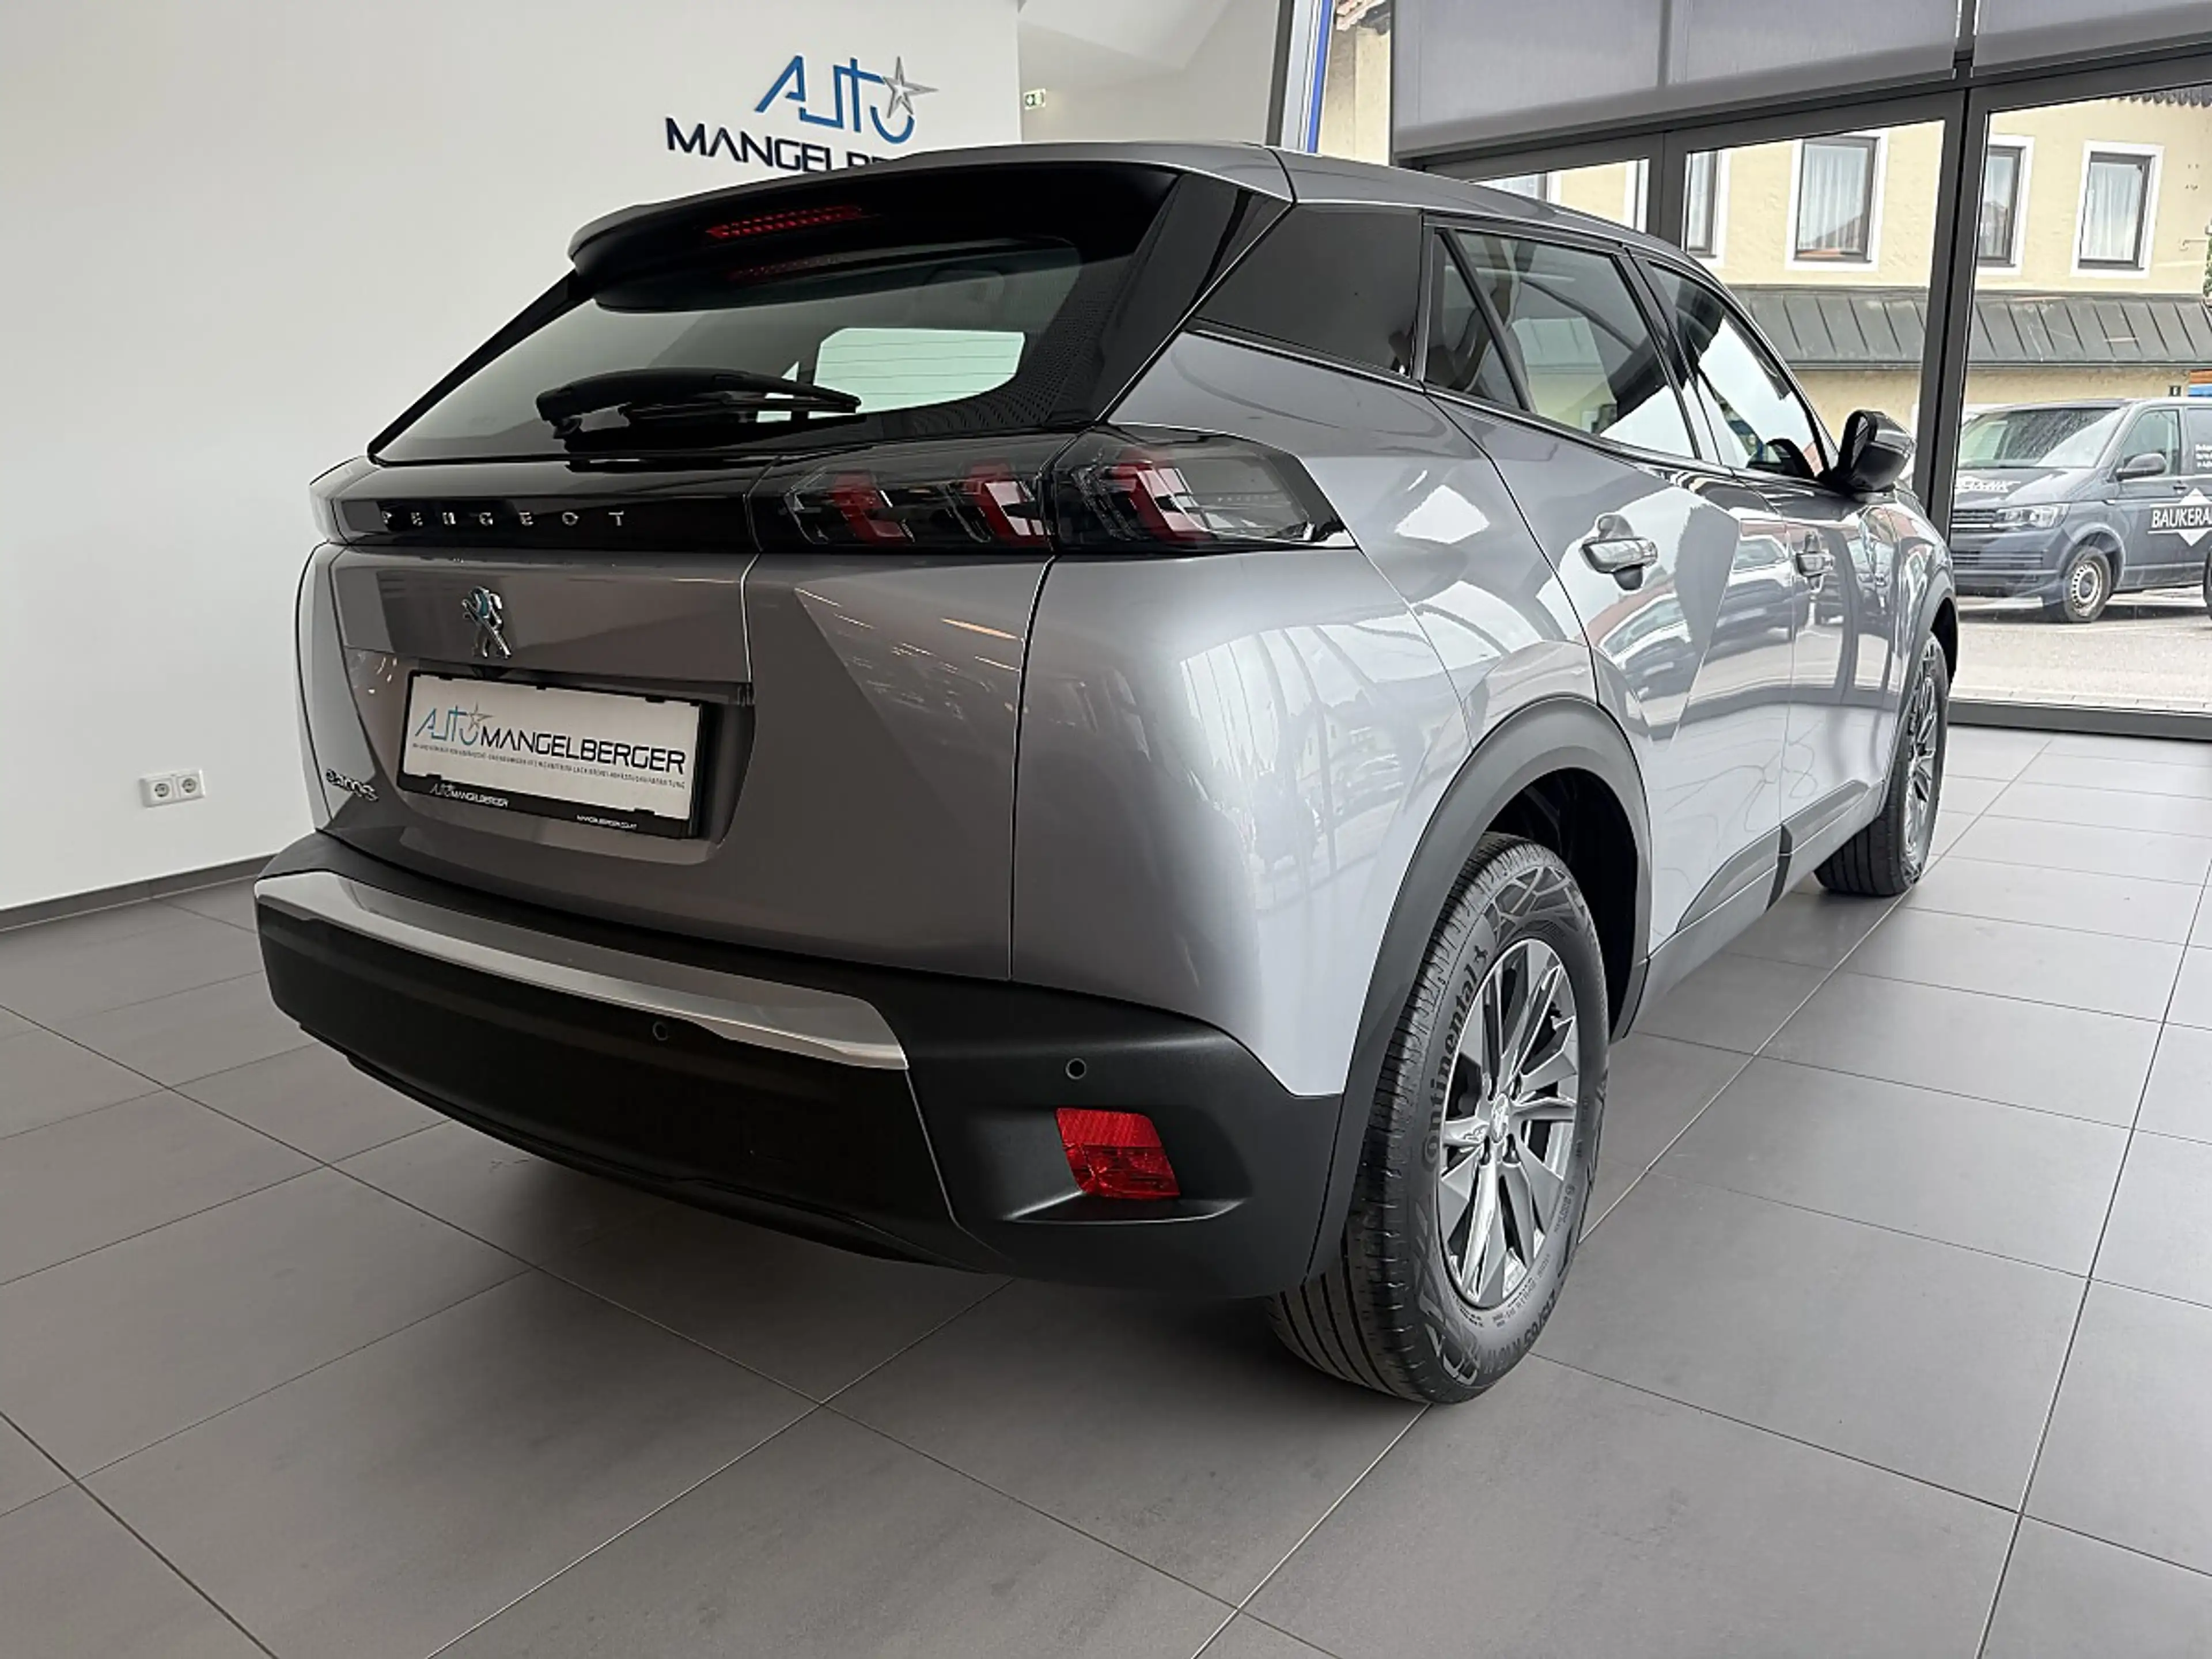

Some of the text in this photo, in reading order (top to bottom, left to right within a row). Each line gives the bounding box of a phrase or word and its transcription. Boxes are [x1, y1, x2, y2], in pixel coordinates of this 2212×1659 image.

[666, 117, 892, 173] MANGEL
[382, 512, 624, 526] PEUGEOT
[481, 726, 685, 775] MANGELBERGER
[1421, 963, 1478, 1172] Continental
